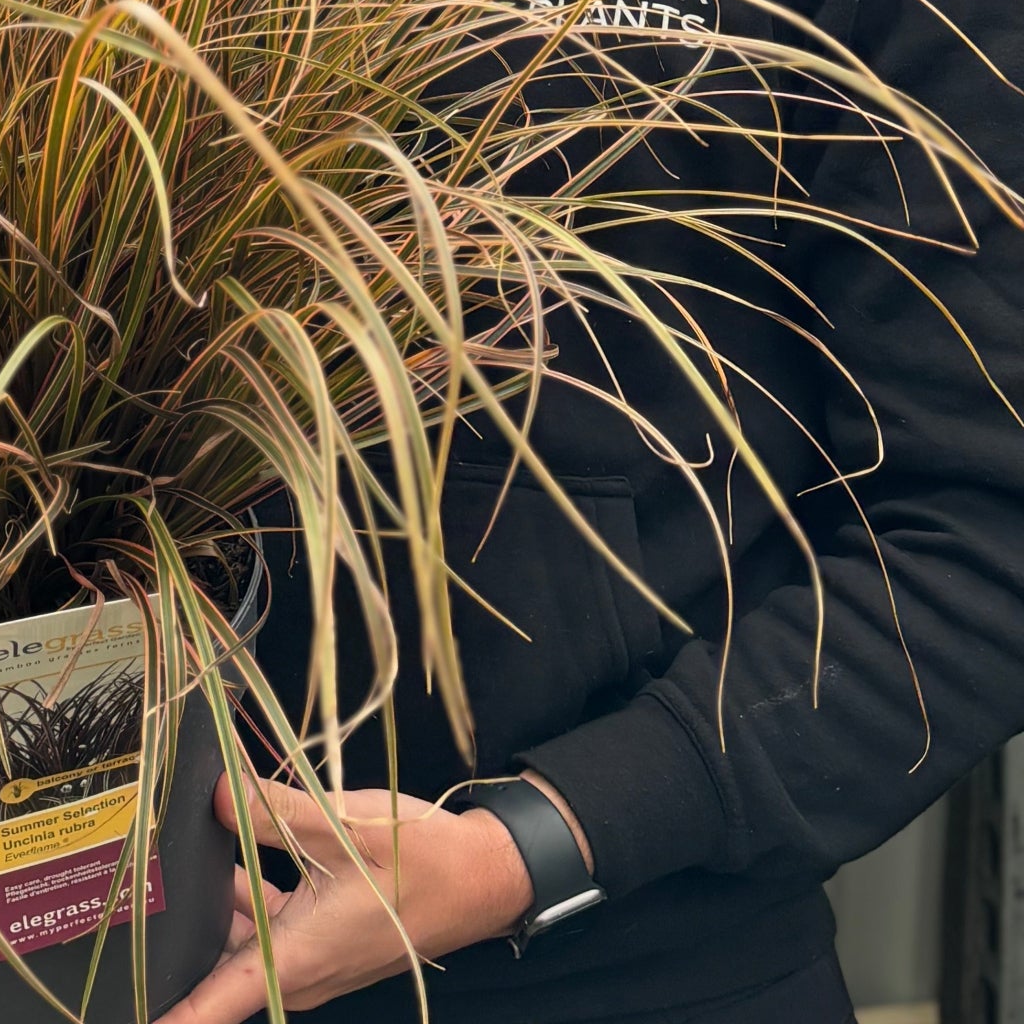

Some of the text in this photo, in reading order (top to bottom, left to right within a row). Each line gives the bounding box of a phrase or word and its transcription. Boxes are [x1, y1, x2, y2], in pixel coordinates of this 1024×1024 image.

[48, 649, 98, 663] grases
[37, 755, 136, 788] balcony or terrac
[1, 794, 126, 837] Summer Selection
[3, 819, 96, 851] Uncinia rubra
[5, 883, 22, 893] Easy
[43, 868, 72, 882] drought
[73, 860, 101, 874] tolerant
[51, 860, 118, 886] trockenheitstoleran
[6, 894, 28, 904] Facile
[9, 880, 153, 933] elegrass.o
